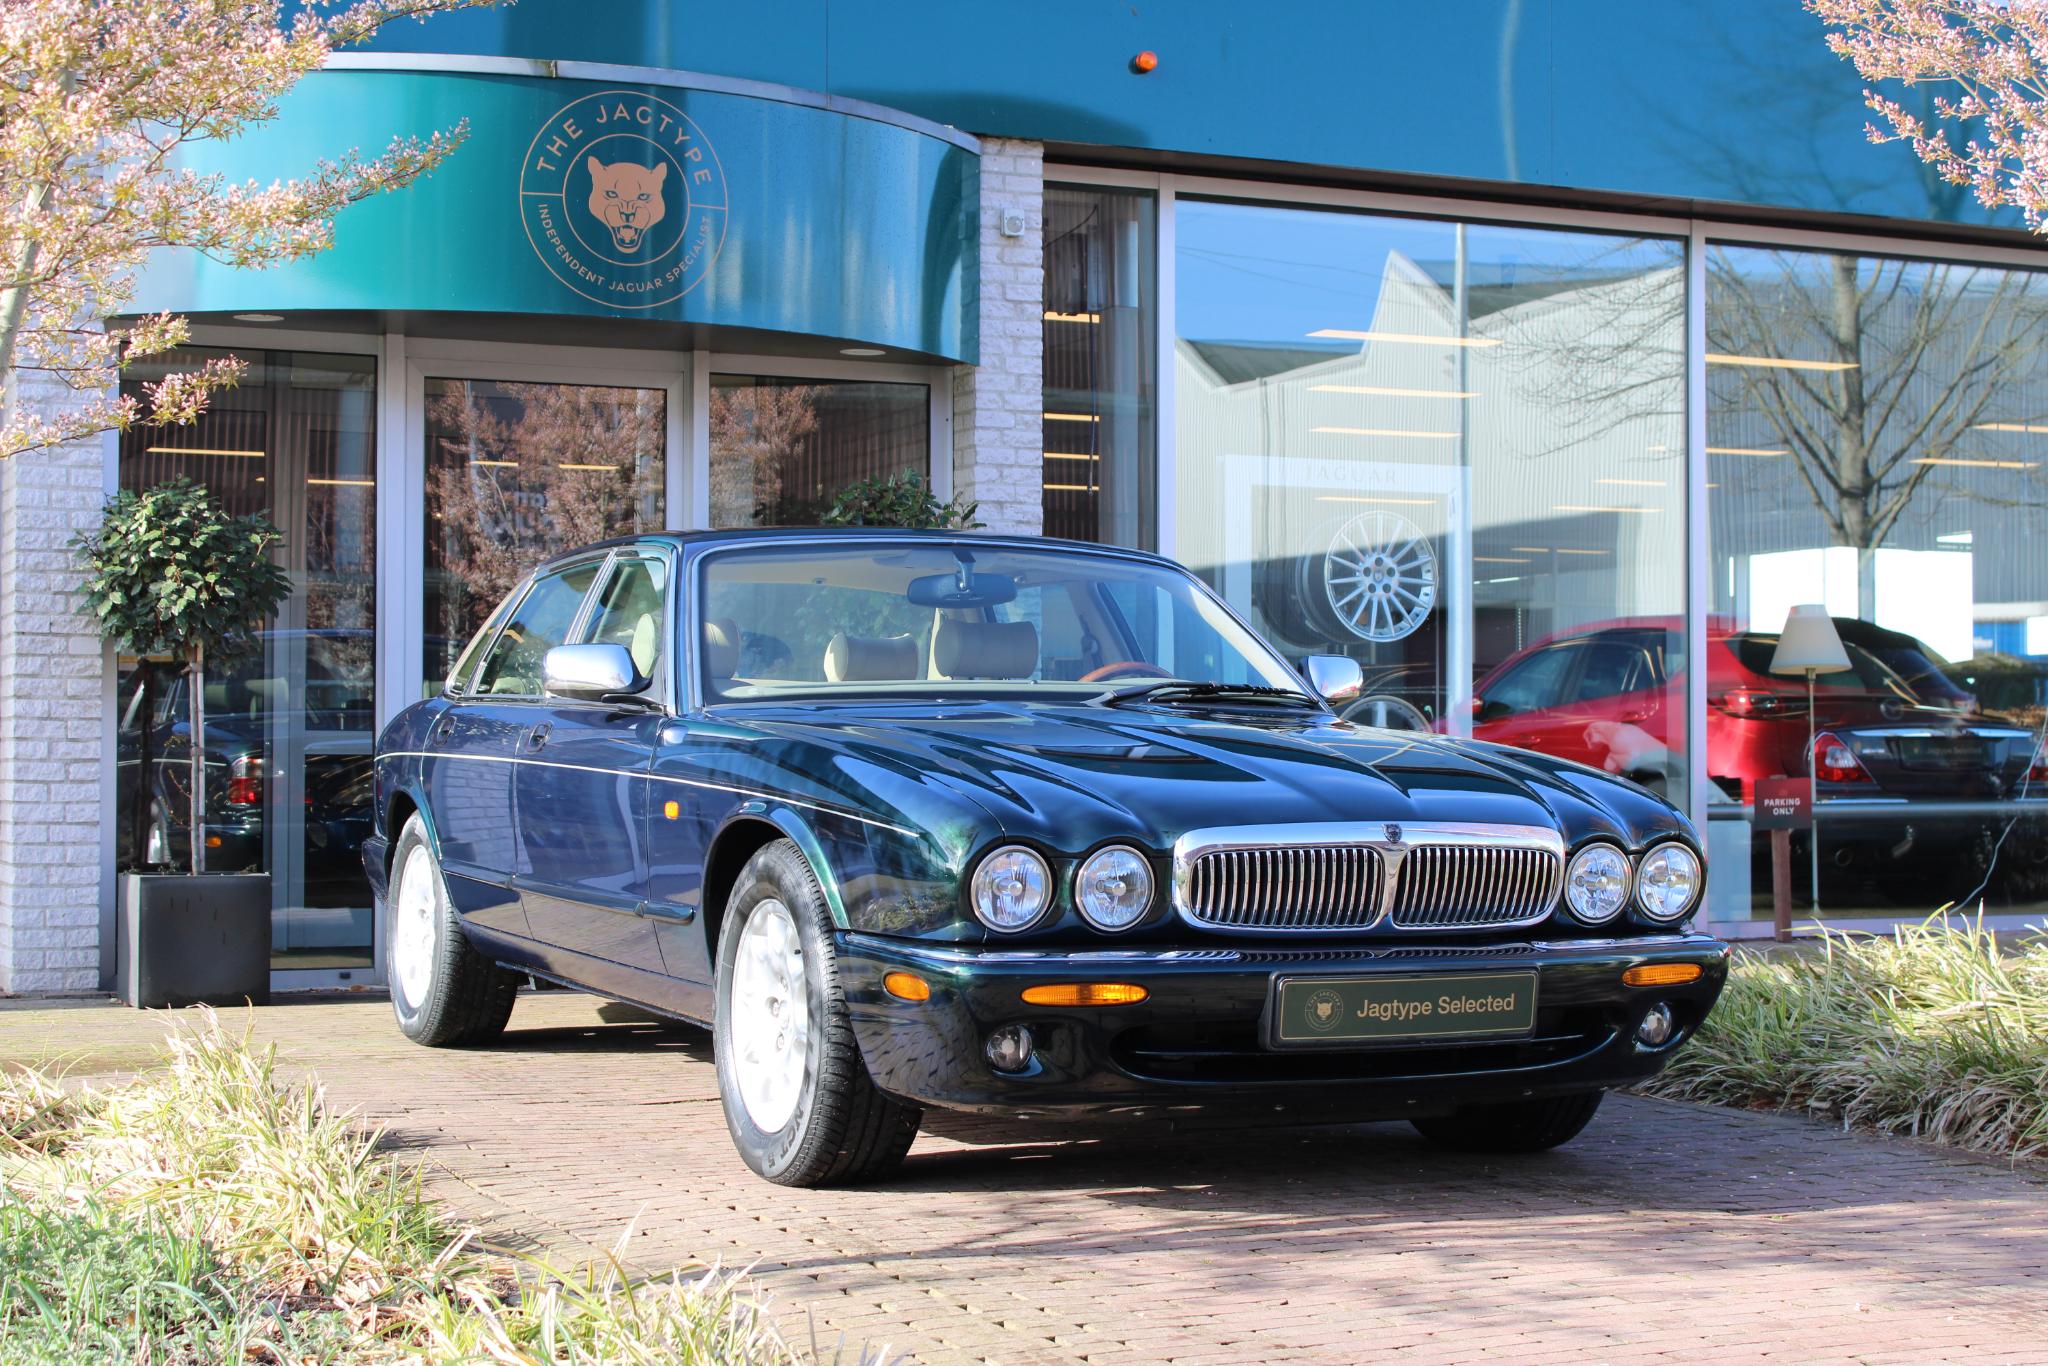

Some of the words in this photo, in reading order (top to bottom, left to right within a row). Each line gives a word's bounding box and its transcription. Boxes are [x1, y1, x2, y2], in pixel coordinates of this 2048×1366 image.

[537, 118, 583, 172] THE
[596, 102, 712, 186] JAGTYPE
[538, 203, 605, 286] INDEPENDENT
[608, 279, 663, 293] JAGUAR
[665, 215, 711, 283] SPECIALIST
[1764, 798, 1800, 807] PARKING
[1773, 807, 1794, 815] ONLY
[1357, 999, 1432, 1021] Jagtype
[1438, 993, 1515, 1014] Selected
